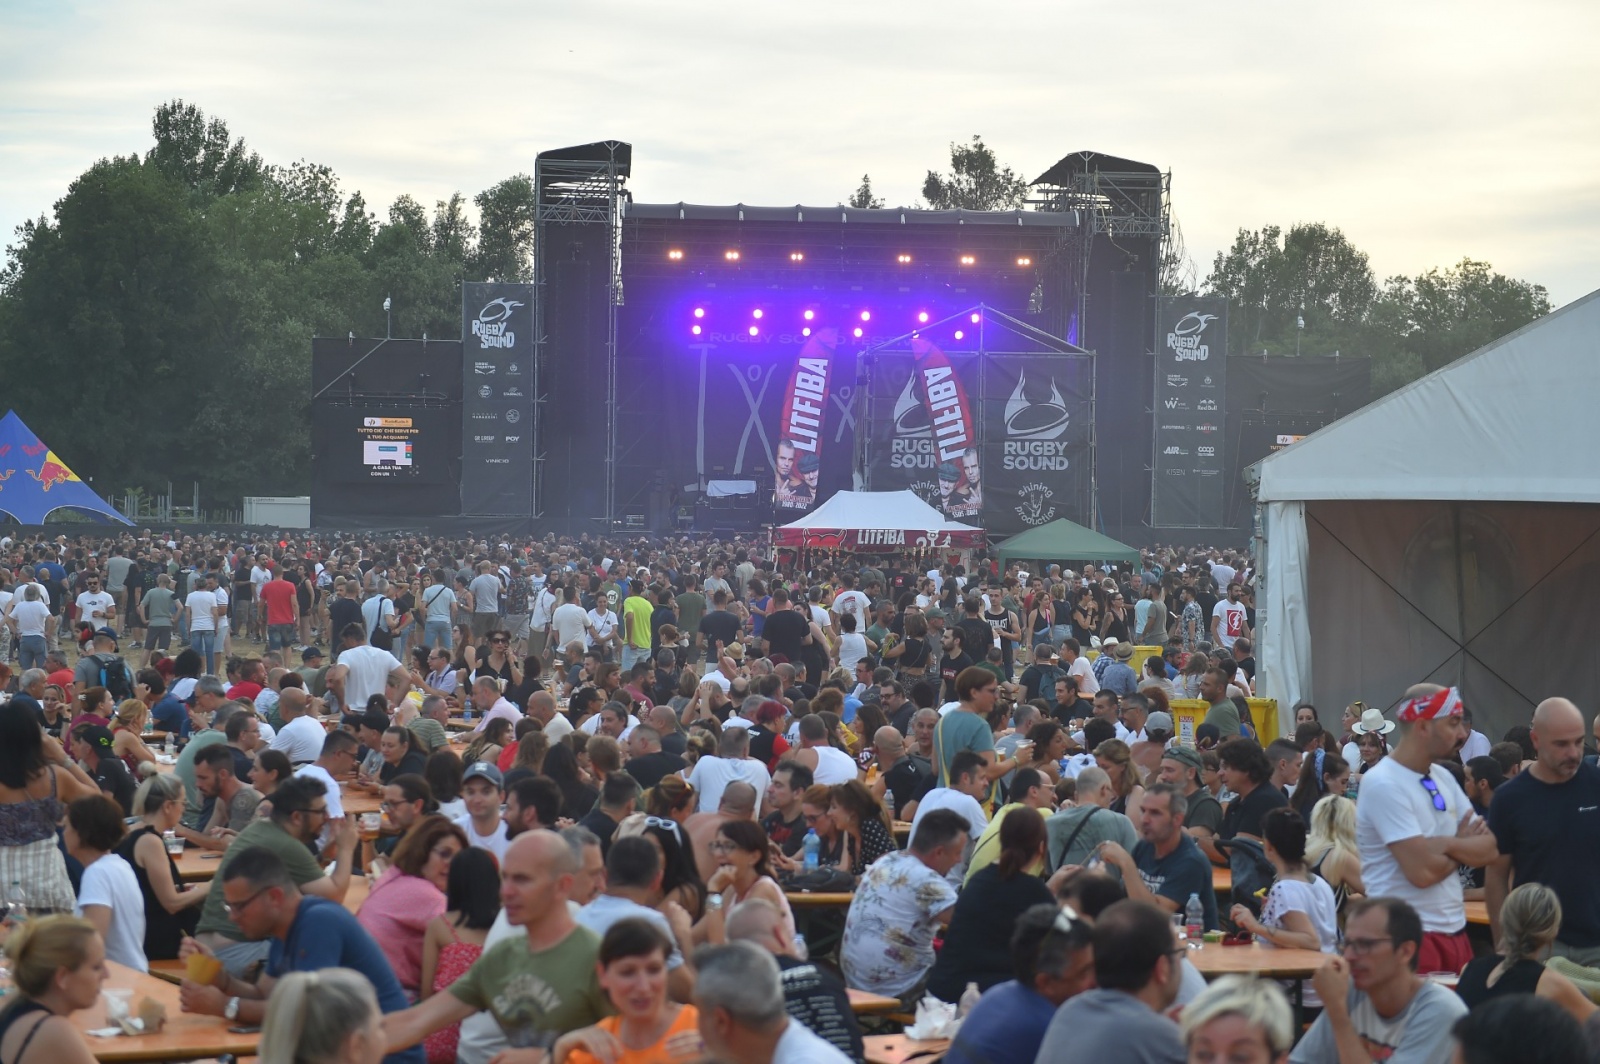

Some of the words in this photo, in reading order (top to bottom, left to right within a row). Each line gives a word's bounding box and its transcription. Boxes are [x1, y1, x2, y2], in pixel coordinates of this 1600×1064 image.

[472, 319, 507, 337] RUGBY
[480, 332, 515, 349] SOUND
[778, 332, 847, 345] SOD
[1167, 332, 1202, 349] RUGBY
[1175, 344, 1209, 361] SOUND
[789, 357, 829, 453] LITFIBA
[892, 438, 935, 454] RUG
[1004, 441, 1069, 456] RUGBY
[1003, 455, 1069, 470] SOUND
[906, 480, 941, 498] hining
[1018, 482, 1054, 499] shining
[1014, 506, 1056, 525] production
[857, 529, 906, 545] LITFIBA
